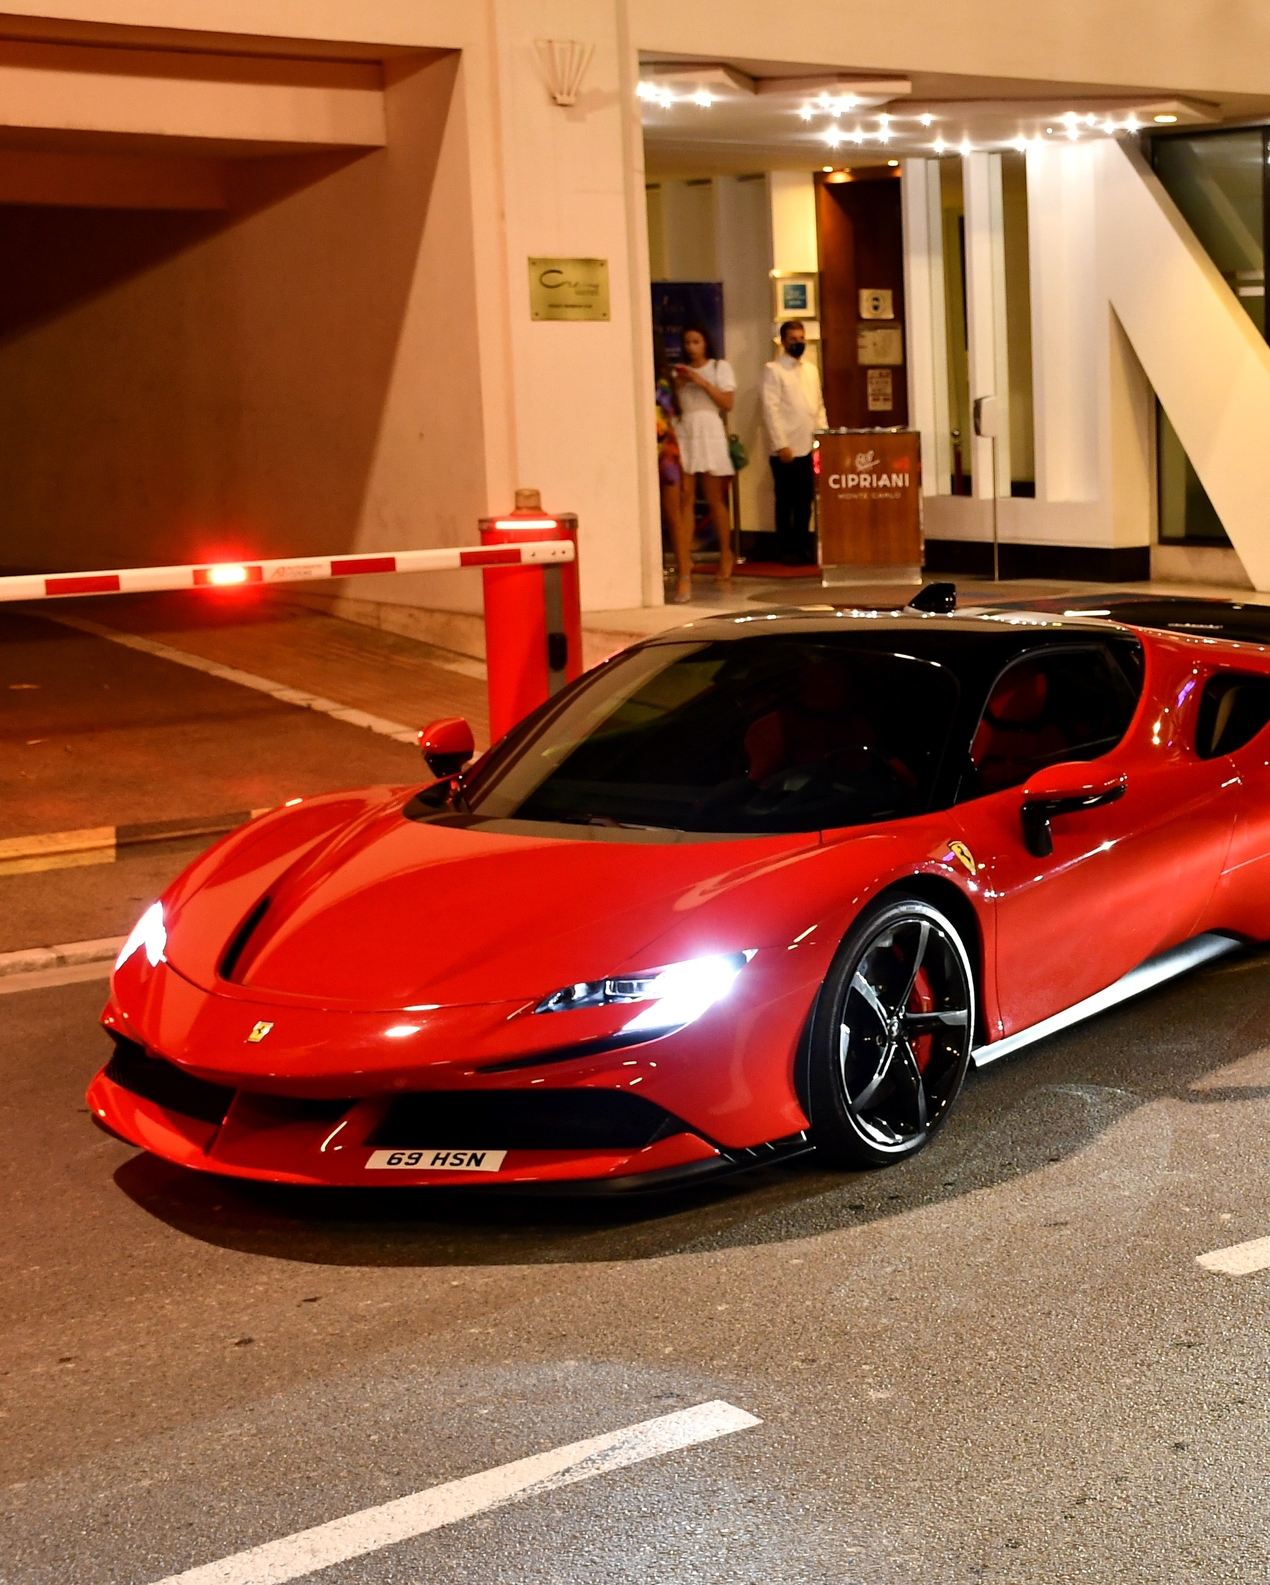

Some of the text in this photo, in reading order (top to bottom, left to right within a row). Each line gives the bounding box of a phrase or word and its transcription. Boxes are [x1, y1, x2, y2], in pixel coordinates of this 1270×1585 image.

[828, 472, 909, 489] CIPRIANI
[387, 1152, 486, 1167] 69 HSN
